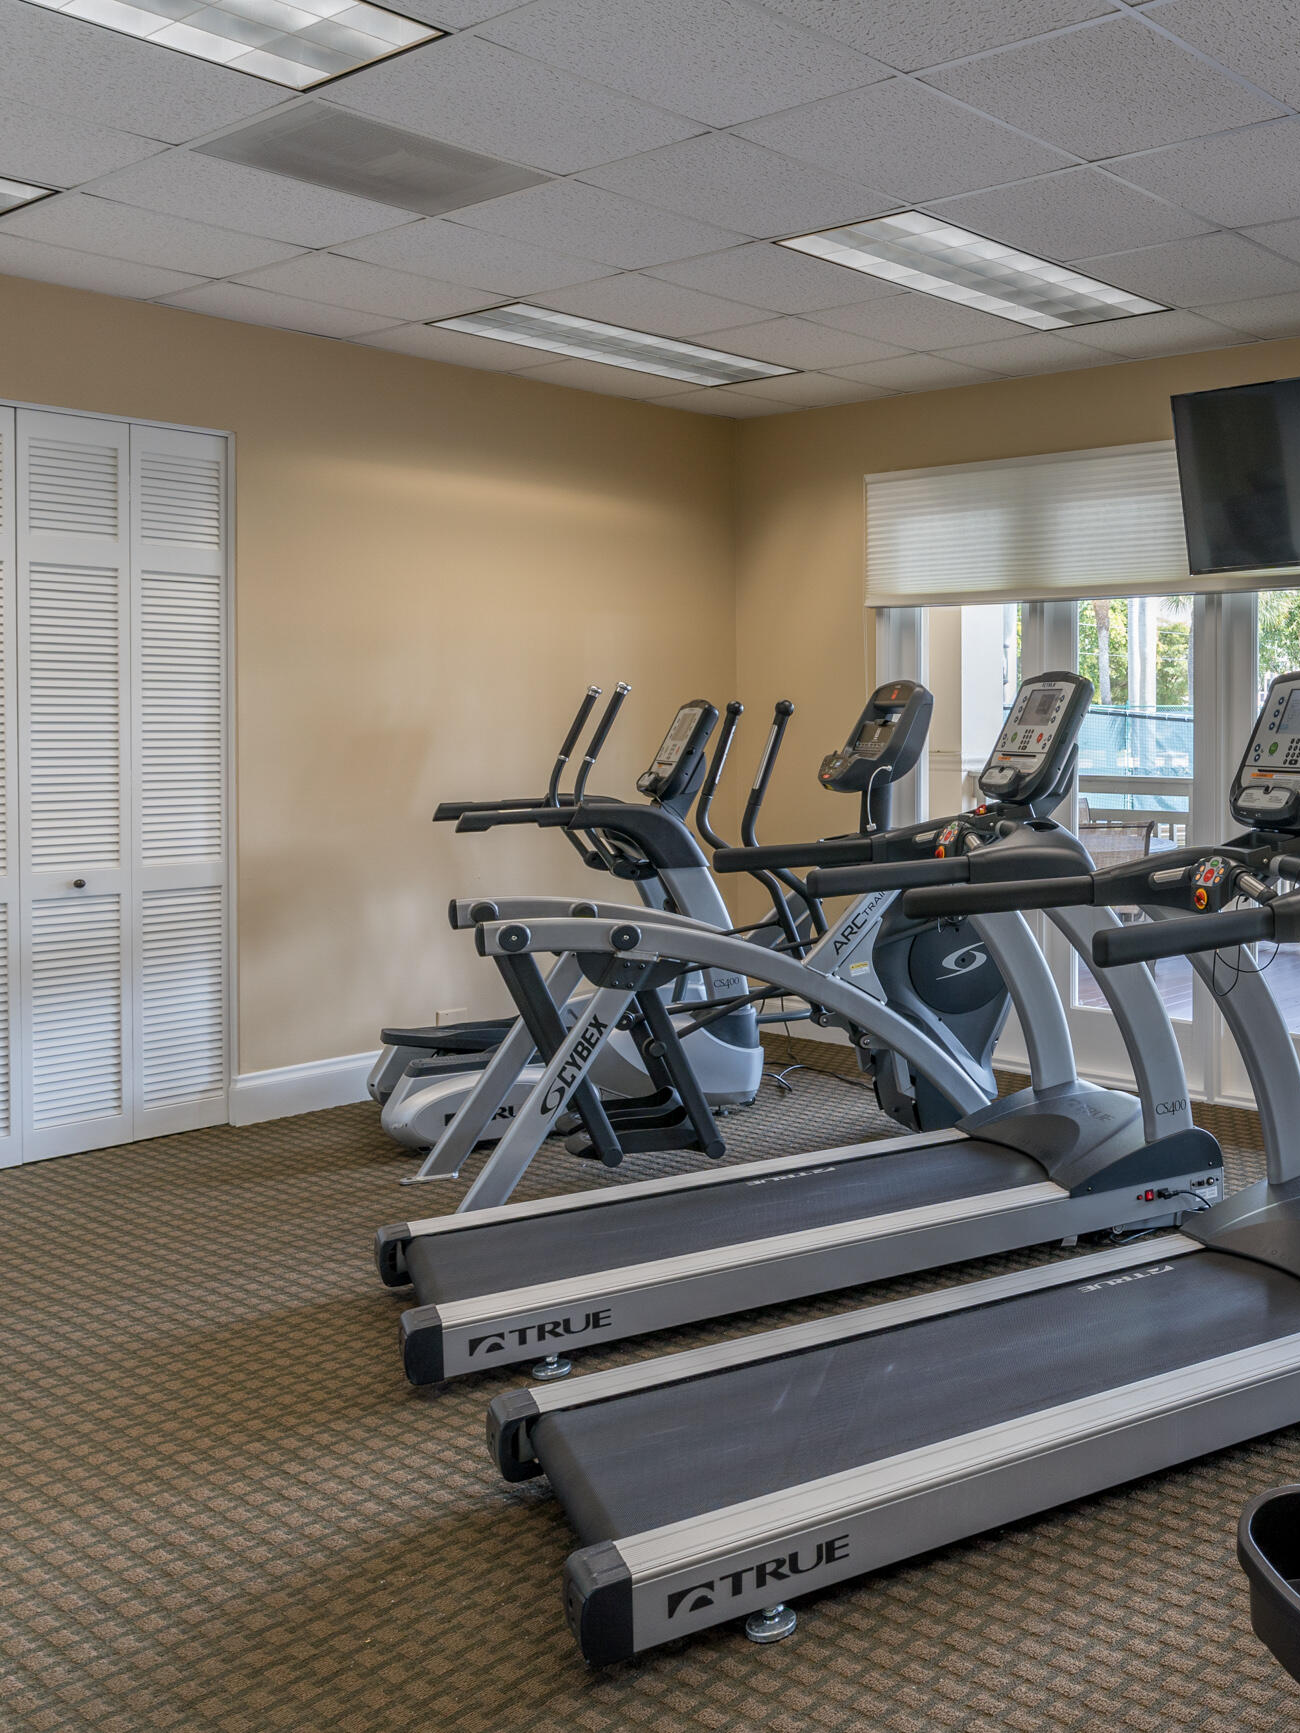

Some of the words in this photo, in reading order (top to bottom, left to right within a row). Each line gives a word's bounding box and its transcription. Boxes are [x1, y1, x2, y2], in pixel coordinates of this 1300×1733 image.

[713, 976, 740, 989] CS400
[557, 1014, 608, 1088] CYBEX
[1155, 1098, 1187, 1116] CS400
[509, 1308, 613, 1346] TRUE
[720, 1534, 851, 1598] TRUE
